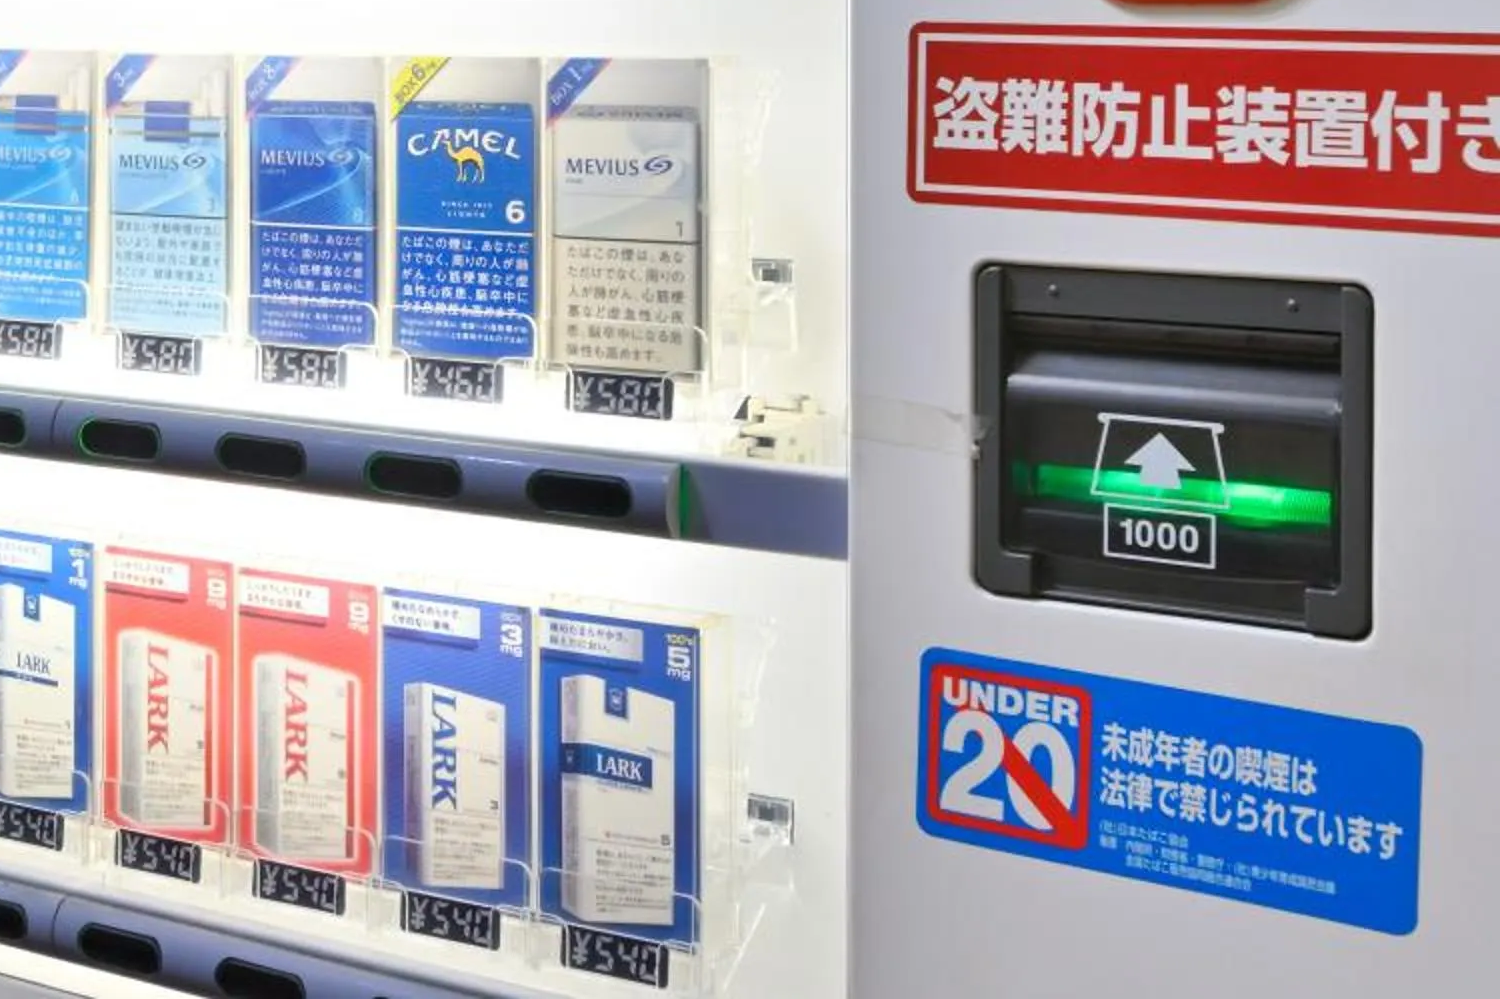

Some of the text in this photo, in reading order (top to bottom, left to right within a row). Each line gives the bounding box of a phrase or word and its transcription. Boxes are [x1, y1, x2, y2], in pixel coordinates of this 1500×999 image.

[119, 152, 179, 172] MEVIUS
[260, 149, 325, 168] MEVIUS
[406, 127, 523, 160] CAMEL
[565, 157, 640, 177] MEVIUS
[505, 199, 527, 225] 6
[675, 221, 685, 238] 1
[263, 348, 339, 386] ¥580
[412, 358, 497, 400] ¥460
[577, 374, 664, 418] ¥580
[1120, 519, 1199, 554] 1000
[71, 558, 86, 579] 1
[15, 650, 51, 675] LARK
[666, 665, 692, 682] mg
[667, 645, 691, 669] 5
[146, 641, 169, 755] LARK
[942, 675, 1080, 728] UNDER
[285, 668, 309, 784] LARK
[432, 692, 457, 811] LARK
[595, 752, 643, 782] LARK
[940, 709, 1076, 832] 20
[1102, 721, 1317, 795] 未成年者の喫煙は
[1100, 767, 1404, 861] 法律で禁じられています
[123, 832, 197, 881] ¥540
[262, 862, 338, 912] ¥540
[410, 893, 493, 947] ¥540
[572, 929, 661, 985] ¥540
